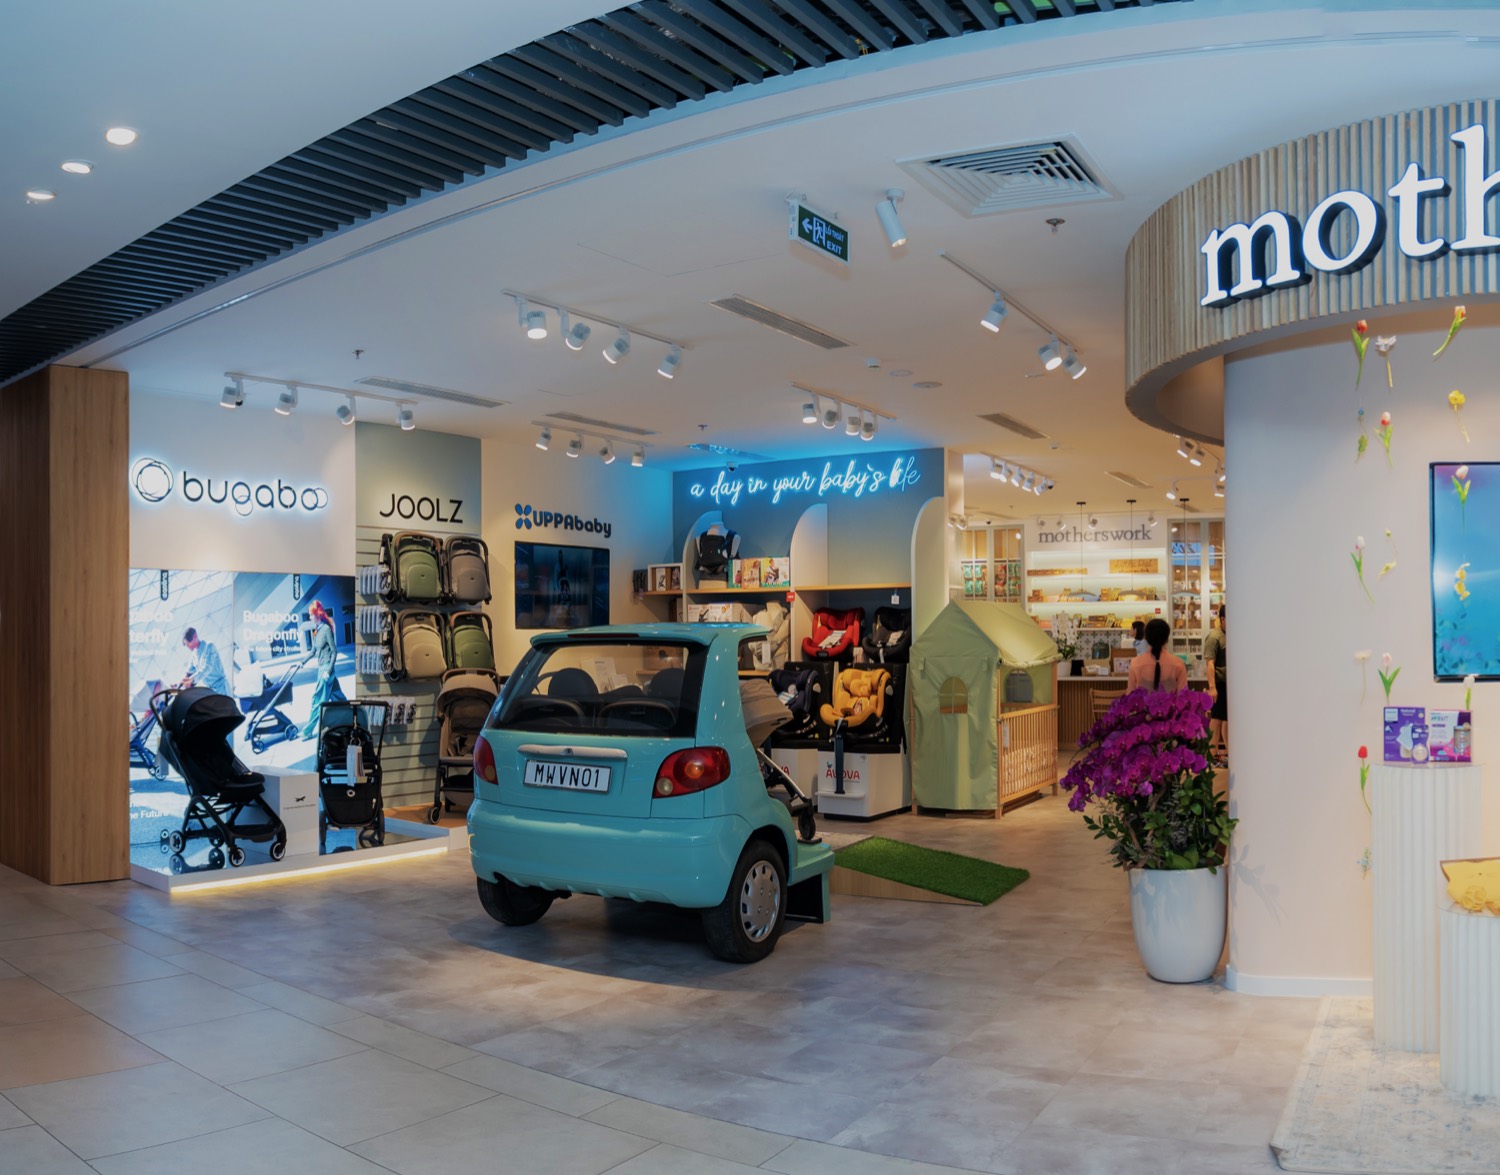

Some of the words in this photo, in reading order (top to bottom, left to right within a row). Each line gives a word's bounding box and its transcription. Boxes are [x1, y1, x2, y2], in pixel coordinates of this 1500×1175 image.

[826, 240, 842, 255] EXIT
[182, 470, 329, 517] bugaboo
[690, 483, 705, 497] a
[710, 470, 744, 505] day
[748, 476, 767, 493] in
[772, 470, 816, 504] your
[379, 493, 464, 524] JOOLZ
[532, 510, 612, 538] UPPAbaby
[1038, 523, 1153, 544] motherswork
[243, 609, 299, 625] Bugaboo
[243, 628, 302, 643] Dragonfly
[534, 763, 600, 788] MWVN01
[140, 808, 169, 820] Future
